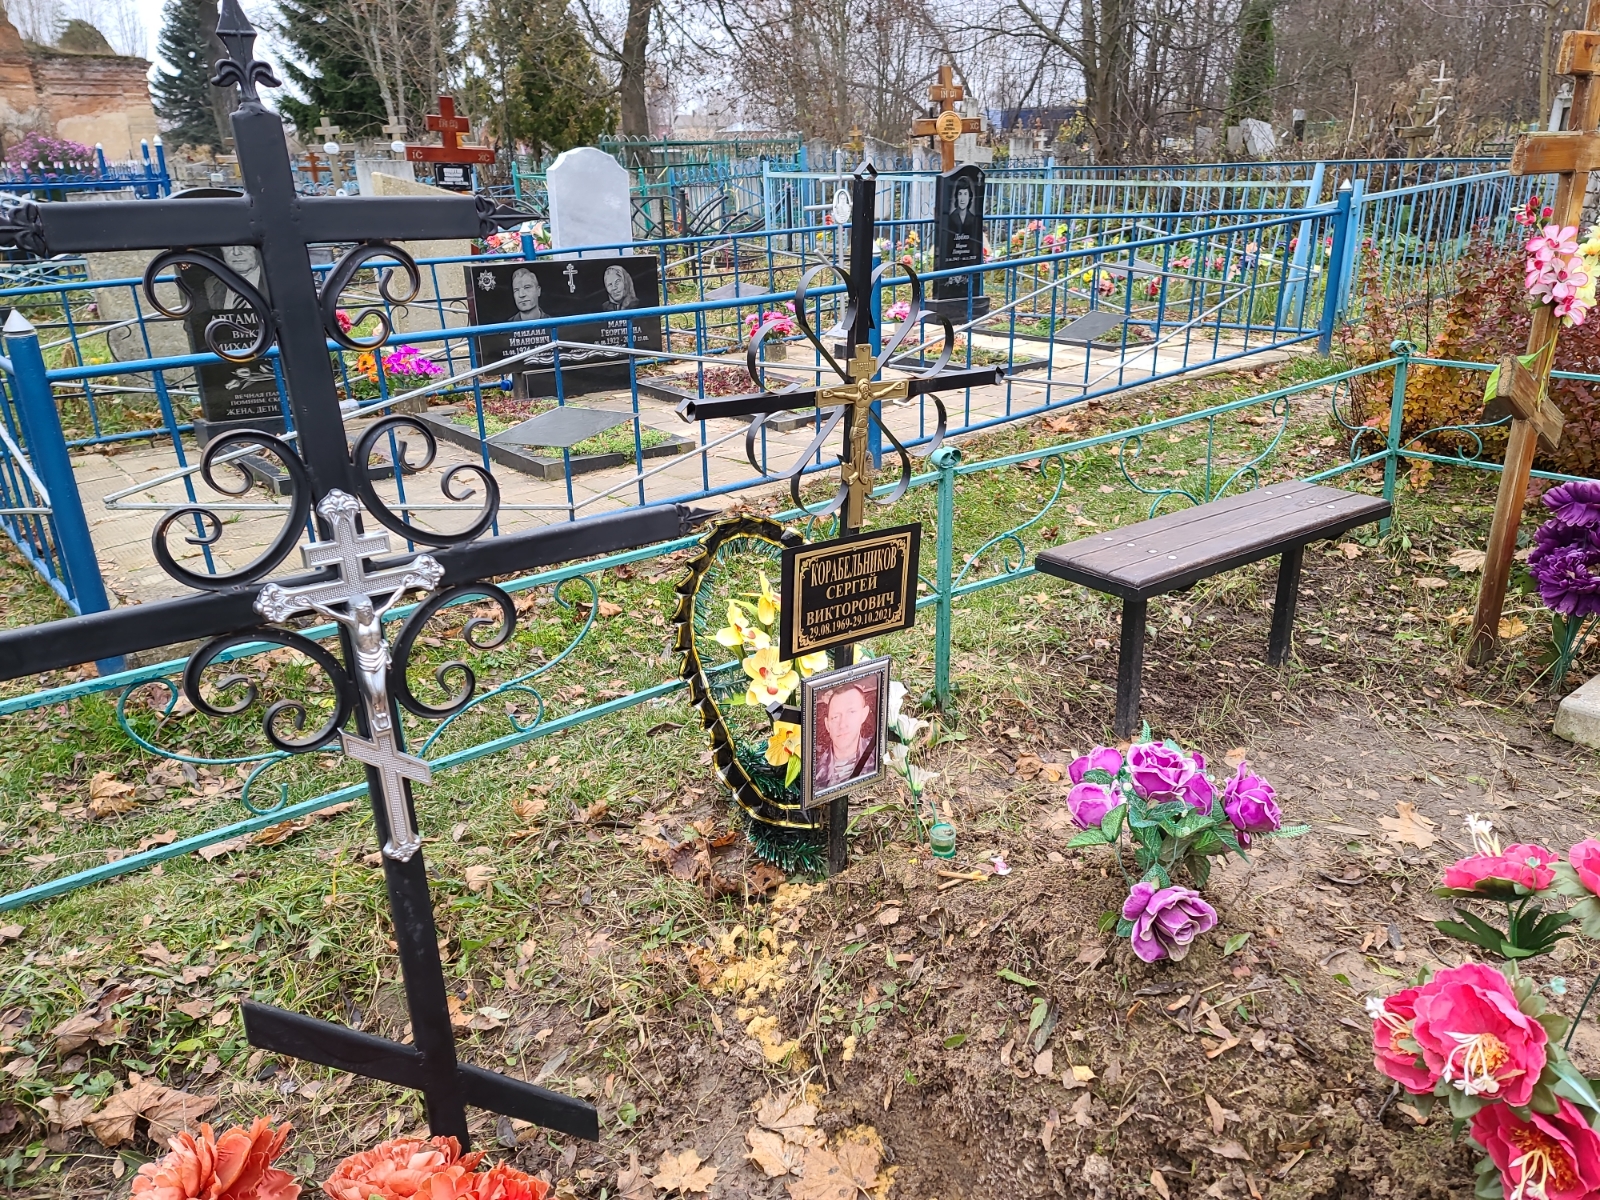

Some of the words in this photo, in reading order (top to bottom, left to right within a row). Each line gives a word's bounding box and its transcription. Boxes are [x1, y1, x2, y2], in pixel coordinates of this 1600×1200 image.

[509, 335, 551, 347] ИВАНОВИЧ
[810, 545, 898, 588] КОРАБЕЛЬНИКОВ
[825, 573, 878, 600] СЕРГЕЙ
[805, 591, 896, 627] ВИКТОРОВИЧ
[808, 606, 893, 640] 29.08.1969-29.10.2021
